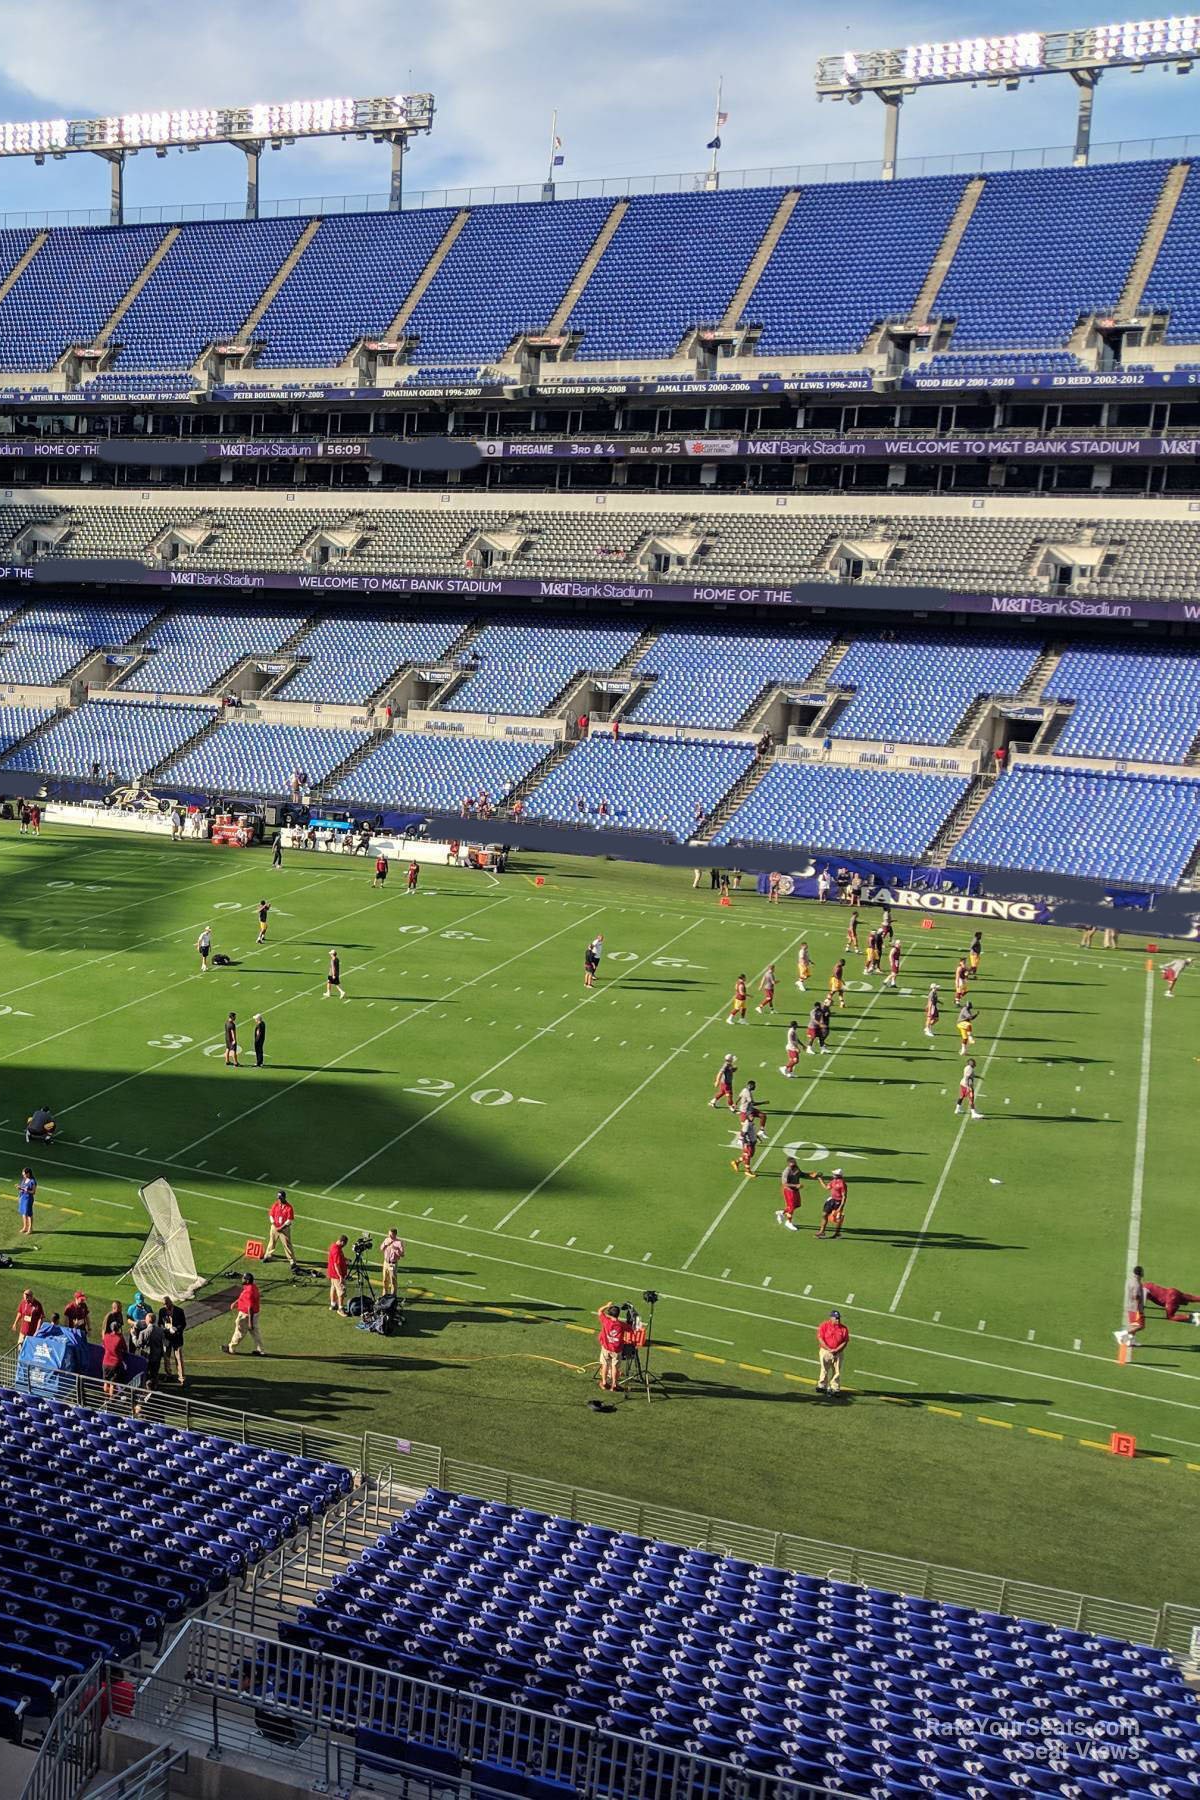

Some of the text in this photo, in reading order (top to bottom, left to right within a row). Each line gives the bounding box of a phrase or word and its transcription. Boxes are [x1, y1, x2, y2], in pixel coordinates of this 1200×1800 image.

[784, 381, 867, 390] RAY LEWIS 1996-2012
[915, 378, 1015, 387] TODD HEAP 2001-2010
[1053, 377, 1066, 385] ED
[1093, 375, 1144, 384] 2002-2012
[382, 388, 481, 397] JONATHAN OGDEN 1996-2007
[558, 386, 585, 394] STOVER
[656, 384, 750, 393] JAMAL LEWIS 2000-2006
[290, 391, 324, 399] 1997-2005
[34, 445, 62, 455] HOME
[66, 446, 81, 455] OF
[220, 444, 311, 455] M&T Bank Stadium
[327, 445, 361, 454] 56:09
[487, 445, 495, 455] 0
[509, 444, 553, 455] PREGAME
[593, 444, 603, 454] &
[606, 444, 615, 454] 4
[630, 446, 648, 454] BALL
[665, 443, 681, 453] 25
[747, 442, 865, 454] M&T Bank Stadium
[885, 441, 1140, 453] WELCOME TO M&T BANK STADIUM
[13, 569, 33, 578] THE
[170, 572, 264, 586] M&T Bank Stadium
[299, 577, 502, 592] WELCOME TO M&T BANK STADIUM
[541, 582, 652, 598] M&T Bank Stadium
[694, 588, 792, 602] HOME OF THE
[991, 598, 1131, 616] M&T Bank Stadium
[147, 1034, 243, 1059] 30
[403, 1078, 514, 1107] 20
[247, 1242, 261, 1257] 20
[1117, 1437, 1131, 1454] G
